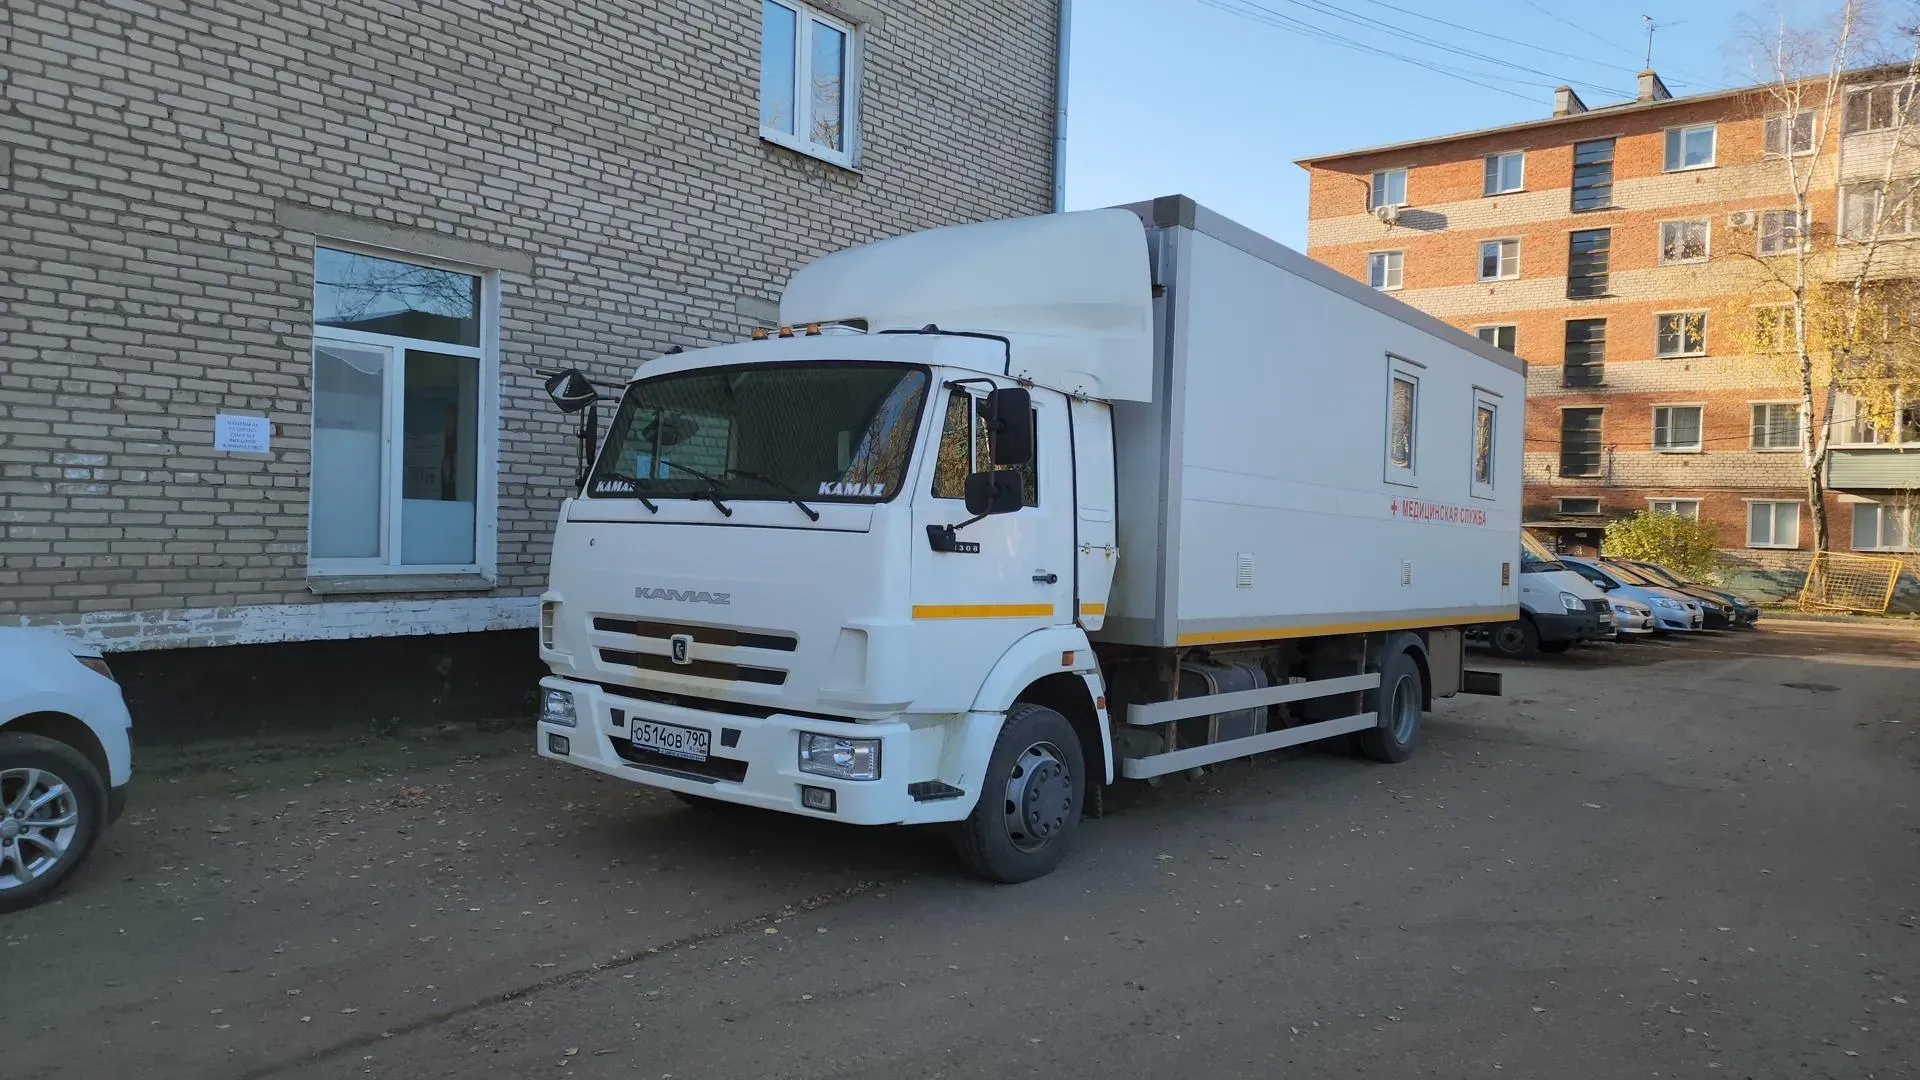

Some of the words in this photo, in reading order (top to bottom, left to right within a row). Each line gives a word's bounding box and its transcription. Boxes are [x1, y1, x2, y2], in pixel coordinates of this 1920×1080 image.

[818, 481, 886, 496] KAMAZ
[1402, 499, 1458, 522] МЕДИЦИНСКАЯ
[1460, 507, 1487, 526] СЛУЖБА
[954, 544, 978, 552] 308
[635, 586, 731, 605] KAMAZ
[685, 730, 706, 747] 790
